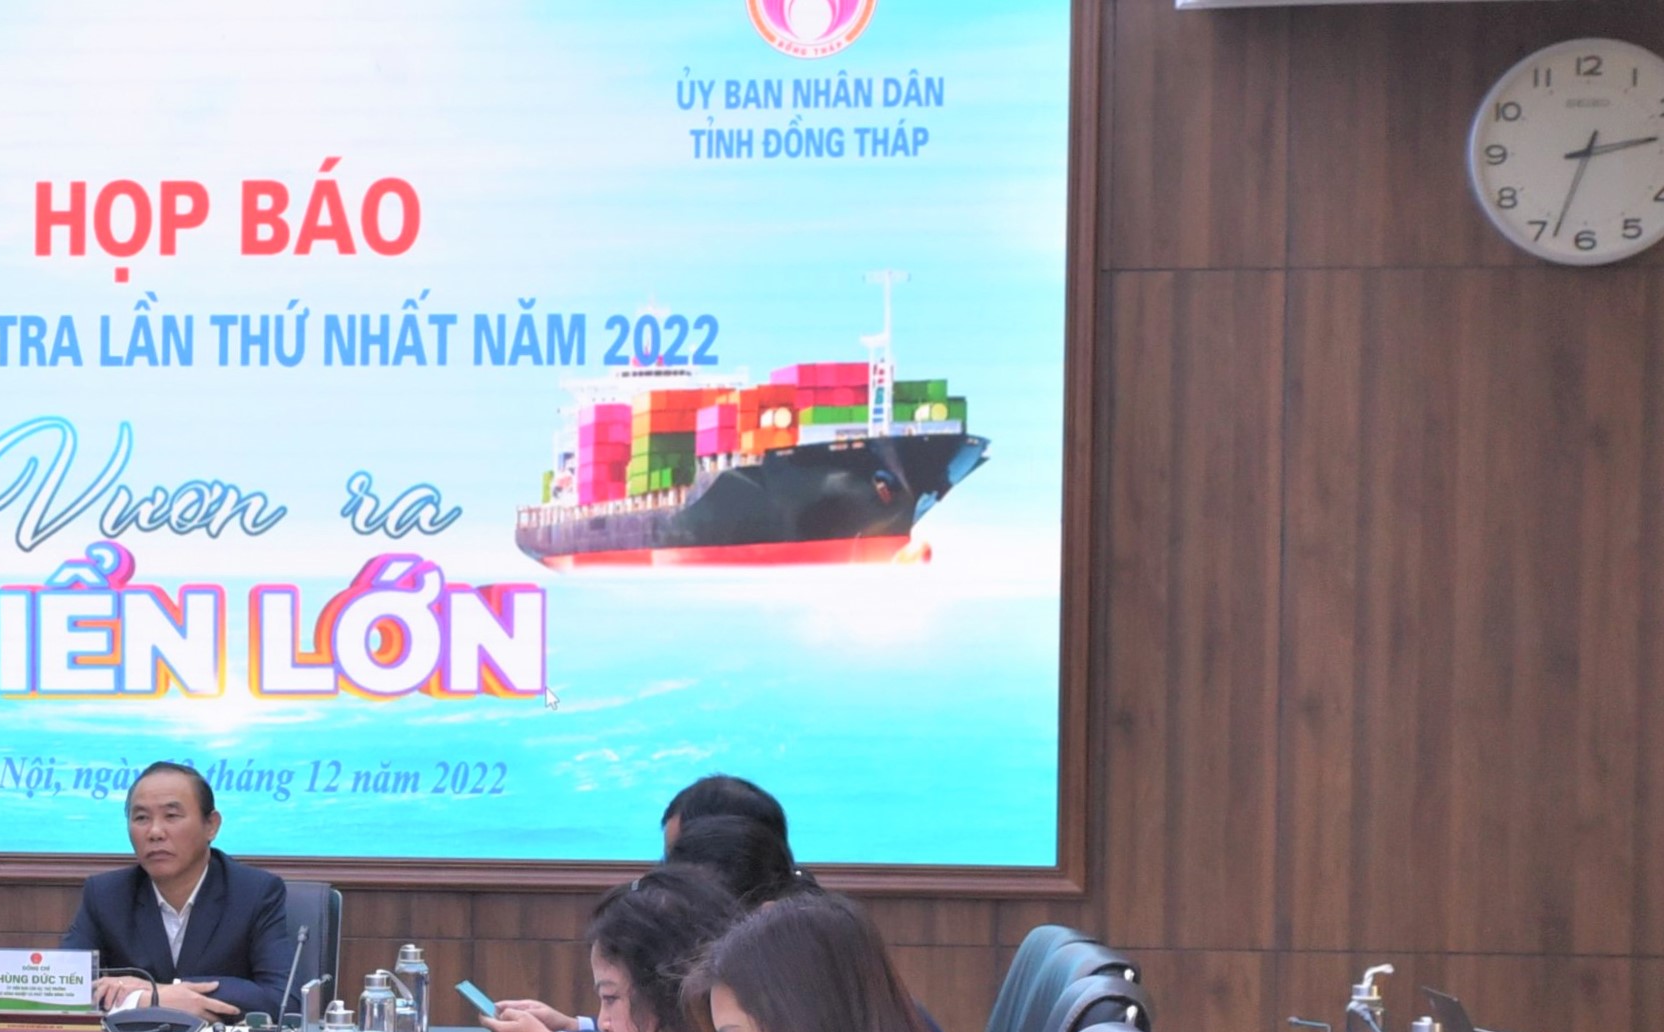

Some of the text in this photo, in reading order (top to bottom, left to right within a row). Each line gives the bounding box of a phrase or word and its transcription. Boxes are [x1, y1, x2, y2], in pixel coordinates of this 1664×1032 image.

[1575, 55, 1603, 76] 12
[676, 66, 945, 110] ỦY BAN NHÂN DÂN
[1533, 67, 1551, 88] 11
[1494, 102, 1522, 122] 10
[689, 114, 930, 159] TỈNH ĐỒNG THÁP
[1485, 144, 1508, 166] 9
[1496, 186, 1518, 209] 8
[34, 156, 421, 283] HỌP BÁO
[1621, 218, 1643, 239] 5
[1527, 220, 1548, 242] 7
[1574, 230, 1597, 251] 6
[100, 291, 195, 367] LẦN
[210, 299, 310, 367] THỨ
[324, 289, 458, 366] NHẤT
[472, 298, 586, 366] NĂM
[603, 314, 720, 366] 2022
[340, 470, 463, 539] ra
[249, 553, 548, 700] LỚN
[206, 757, 296, 802] tháng
[305, 760, 343, 793] 12
[351, 760, 421, 794] năm
[430, 761, 509, 795] 2022
[31, 972, 57, 985] ĐỨC
[59, 971, 85, 986] TIẾN
